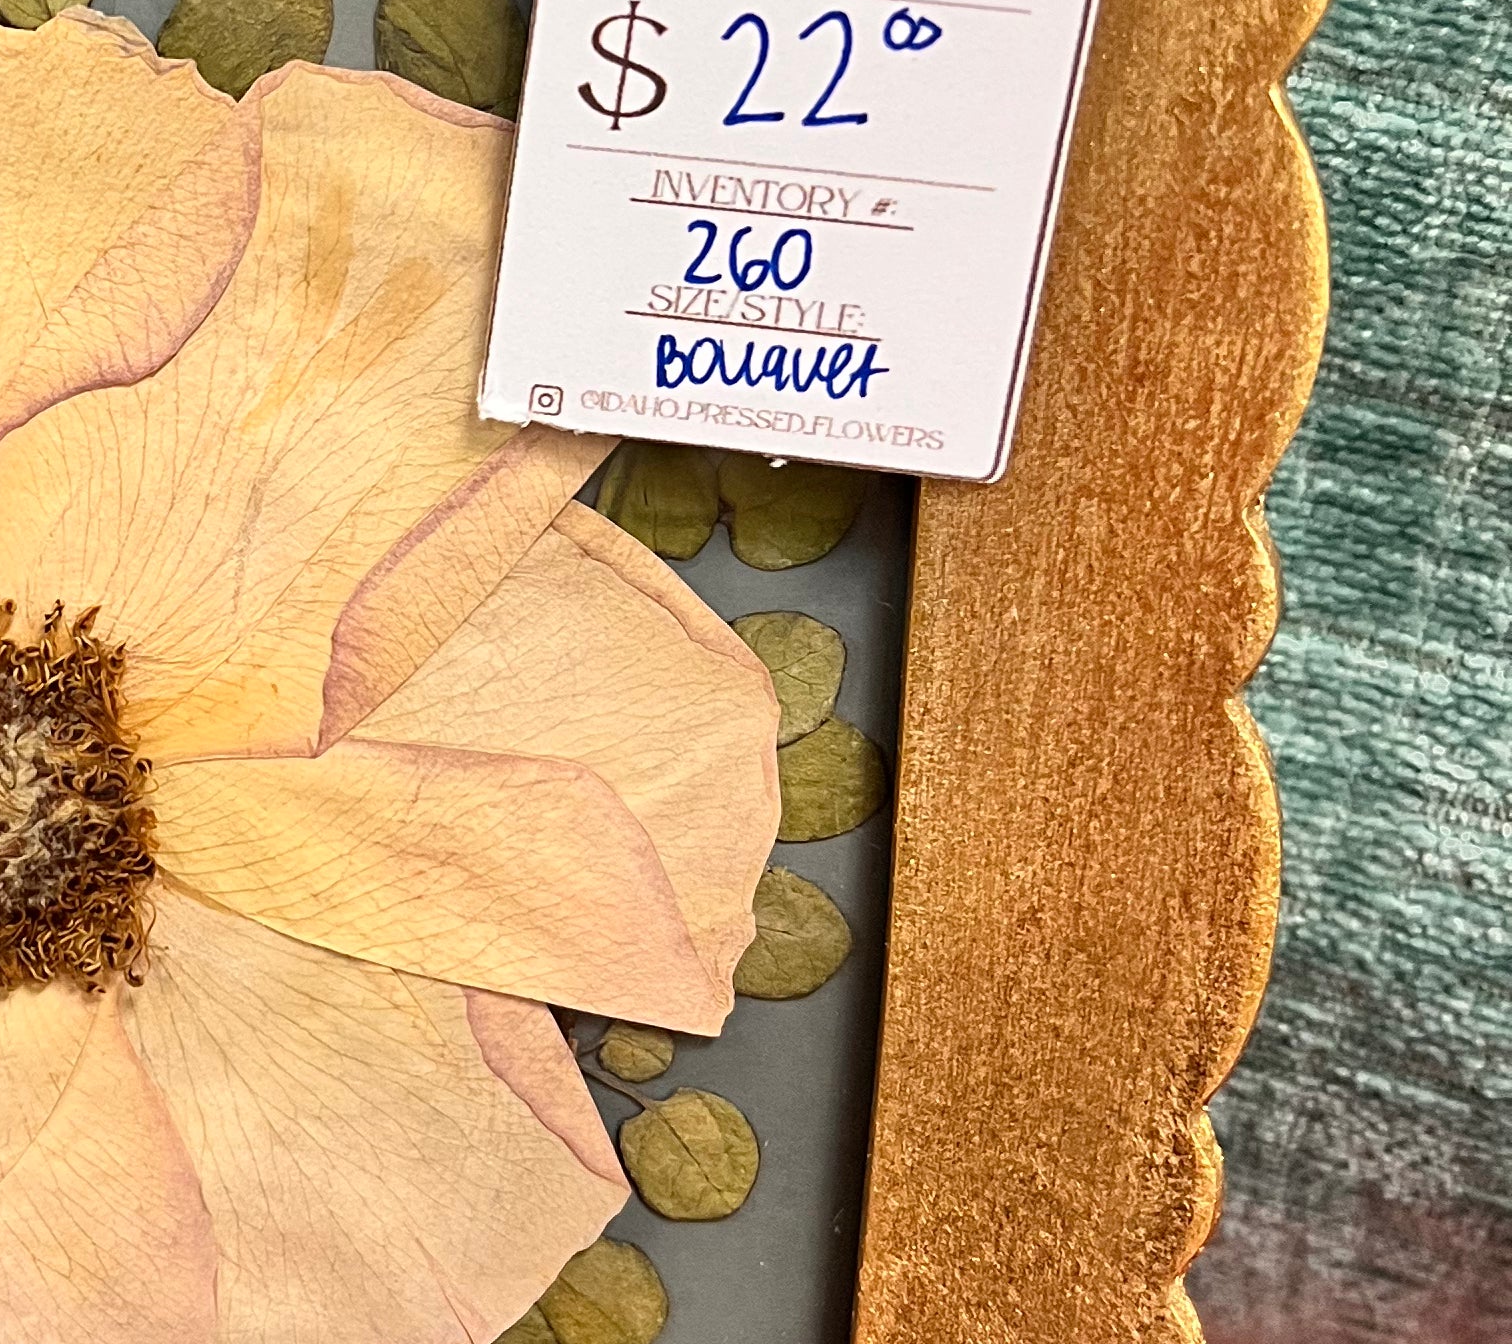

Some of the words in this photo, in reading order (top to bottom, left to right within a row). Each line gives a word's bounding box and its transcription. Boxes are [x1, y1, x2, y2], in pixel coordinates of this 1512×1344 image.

[577, 0, 669, 131] $
[649, 168, 863, 218] INVENTORY
[683, 218, 813, 292] 260
[646, 283, 868, 335] SIZE/STYLE:
